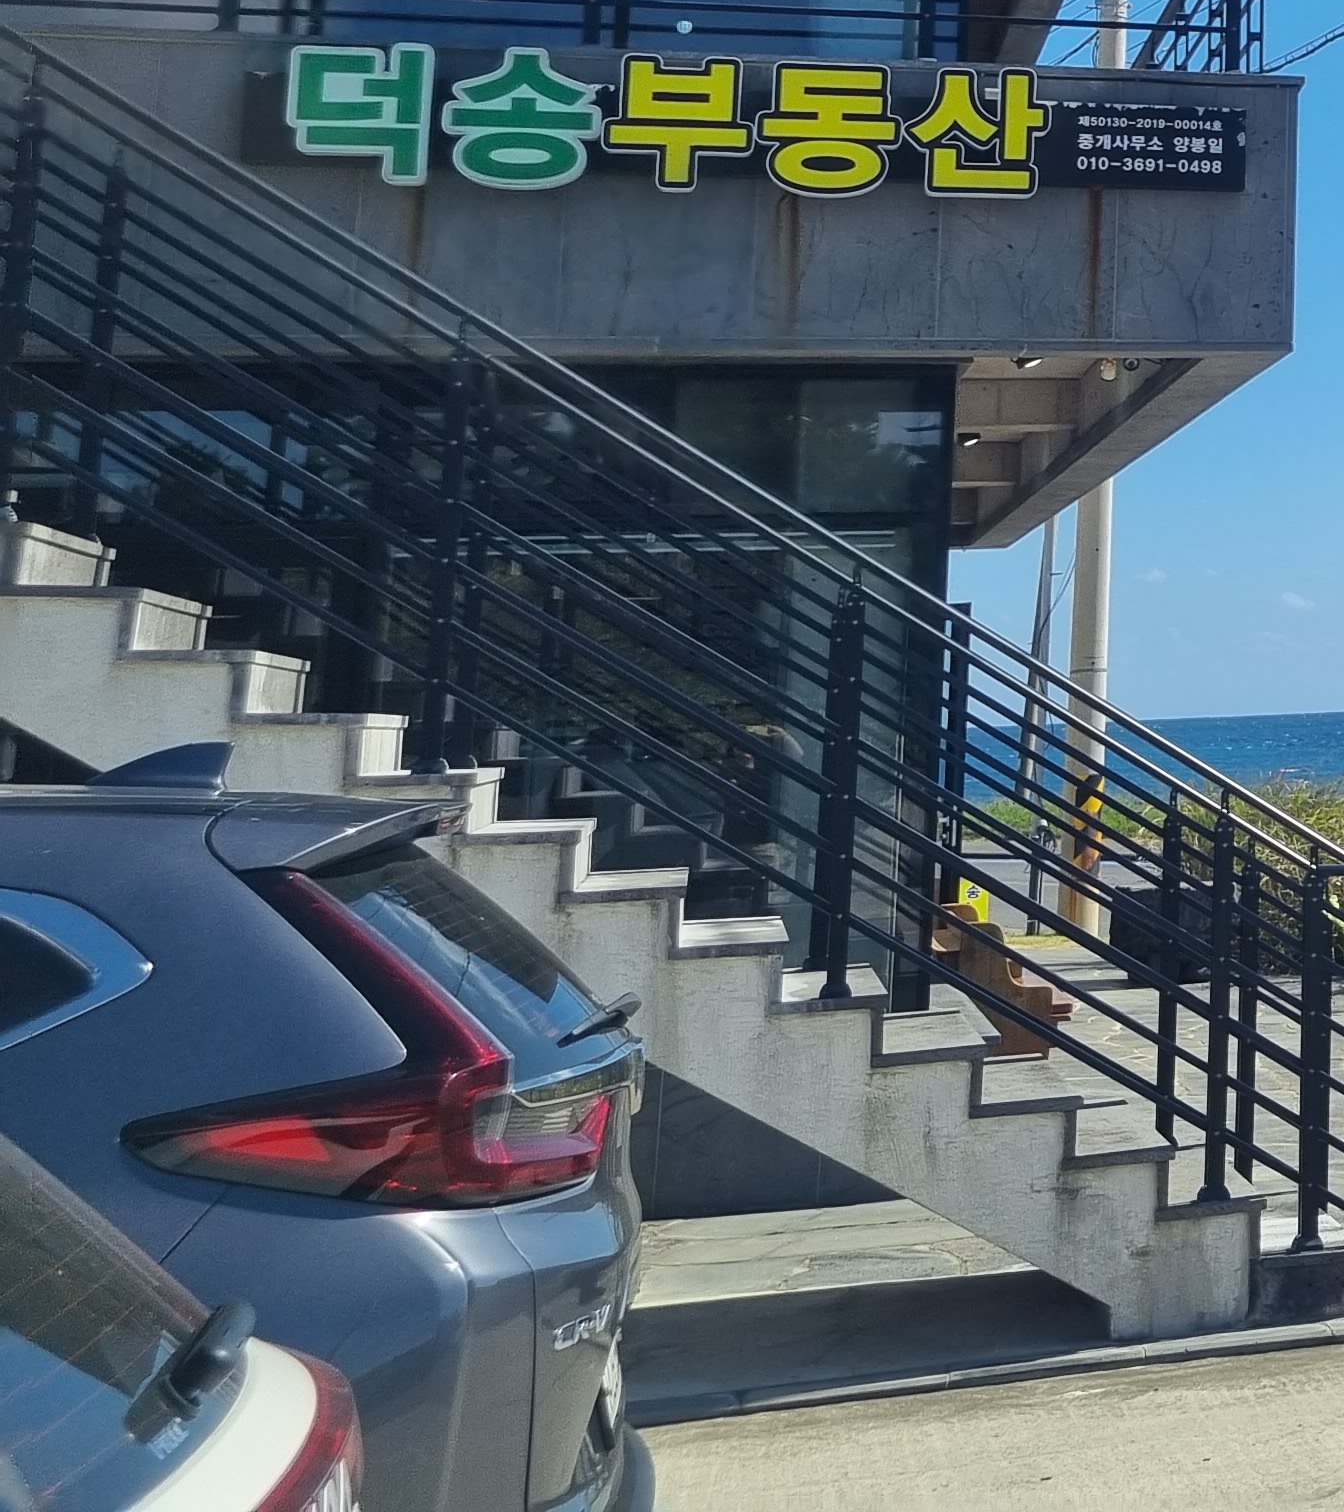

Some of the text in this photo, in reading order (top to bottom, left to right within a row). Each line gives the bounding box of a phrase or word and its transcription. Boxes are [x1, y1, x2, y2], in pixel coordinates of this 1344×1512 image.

[1077, 133, 1223, 154] 중개사무소 양봉일
[1076, 156, 1223, 174] 010-3691-0498
